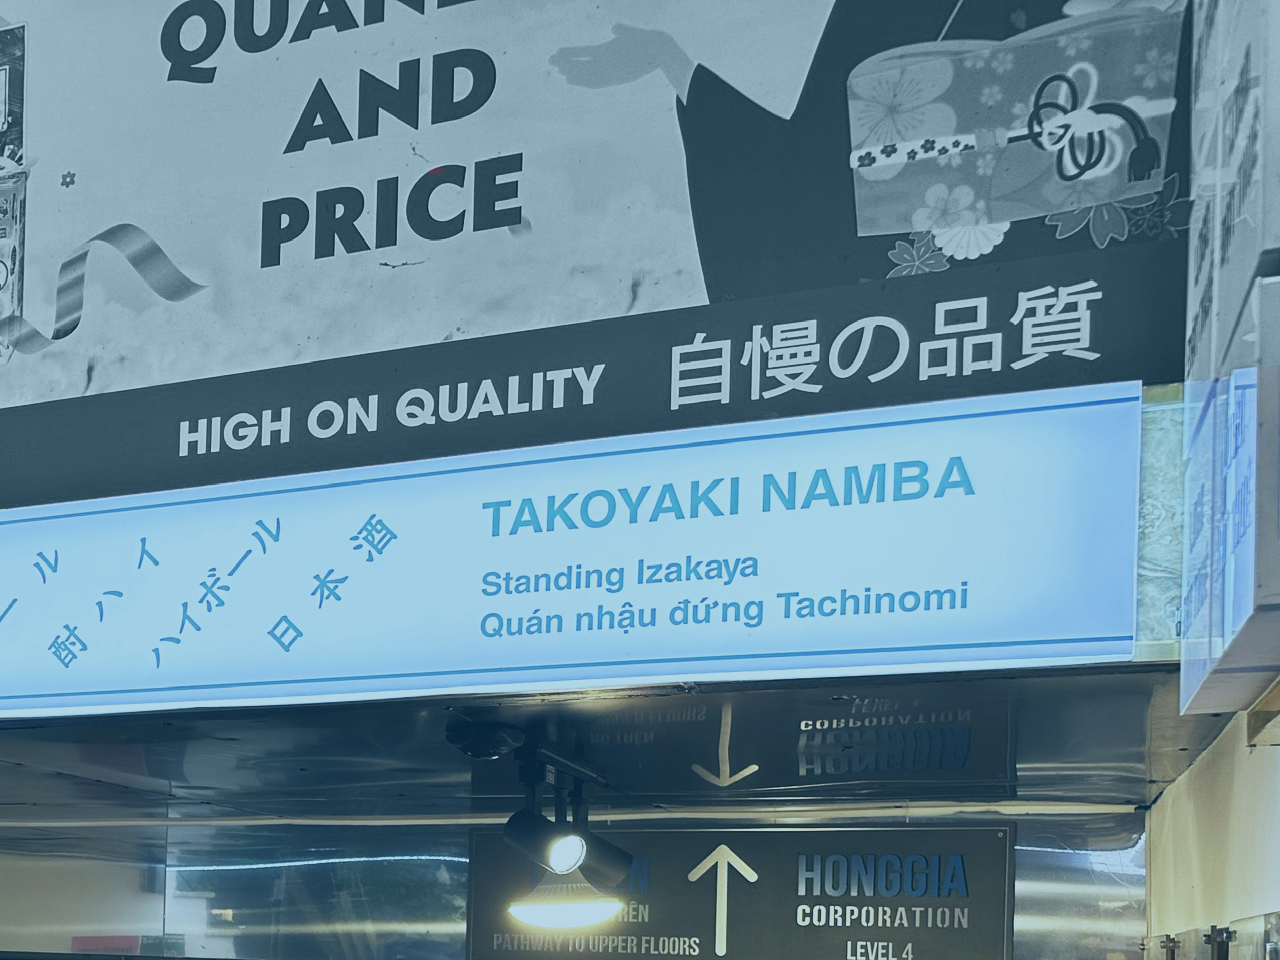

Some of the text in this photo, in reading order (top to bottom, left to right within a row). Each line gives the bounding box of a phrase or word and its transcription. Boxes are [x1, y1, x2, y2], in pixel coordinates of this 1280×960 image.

[282, 48, 497, 155] AND
[260, 152, 524, 269] PRICE
[667, 280, 1104, 412] 自慢の品質
[177, 364, 607, 457] HIGH ON QUALITY
[481, 455, 977, 538] TAKOYAKI NAMBA
[151, 516, 283, 670] ハイボール
[266, 512, 399, 653] 日本酒
[480, 581, 969, 640] Quán nhậu đứng Tachinomi
[481, 554, 759, 597] Standing Izakaya
[796, 904, 969, 929] CORPORATION
[797, 854, 969, 897] HONGGIA
[493, 933, 700, 956] PATHWAY TO UPPER FLOORS
[846, 940, 898, 960] LEVEL
